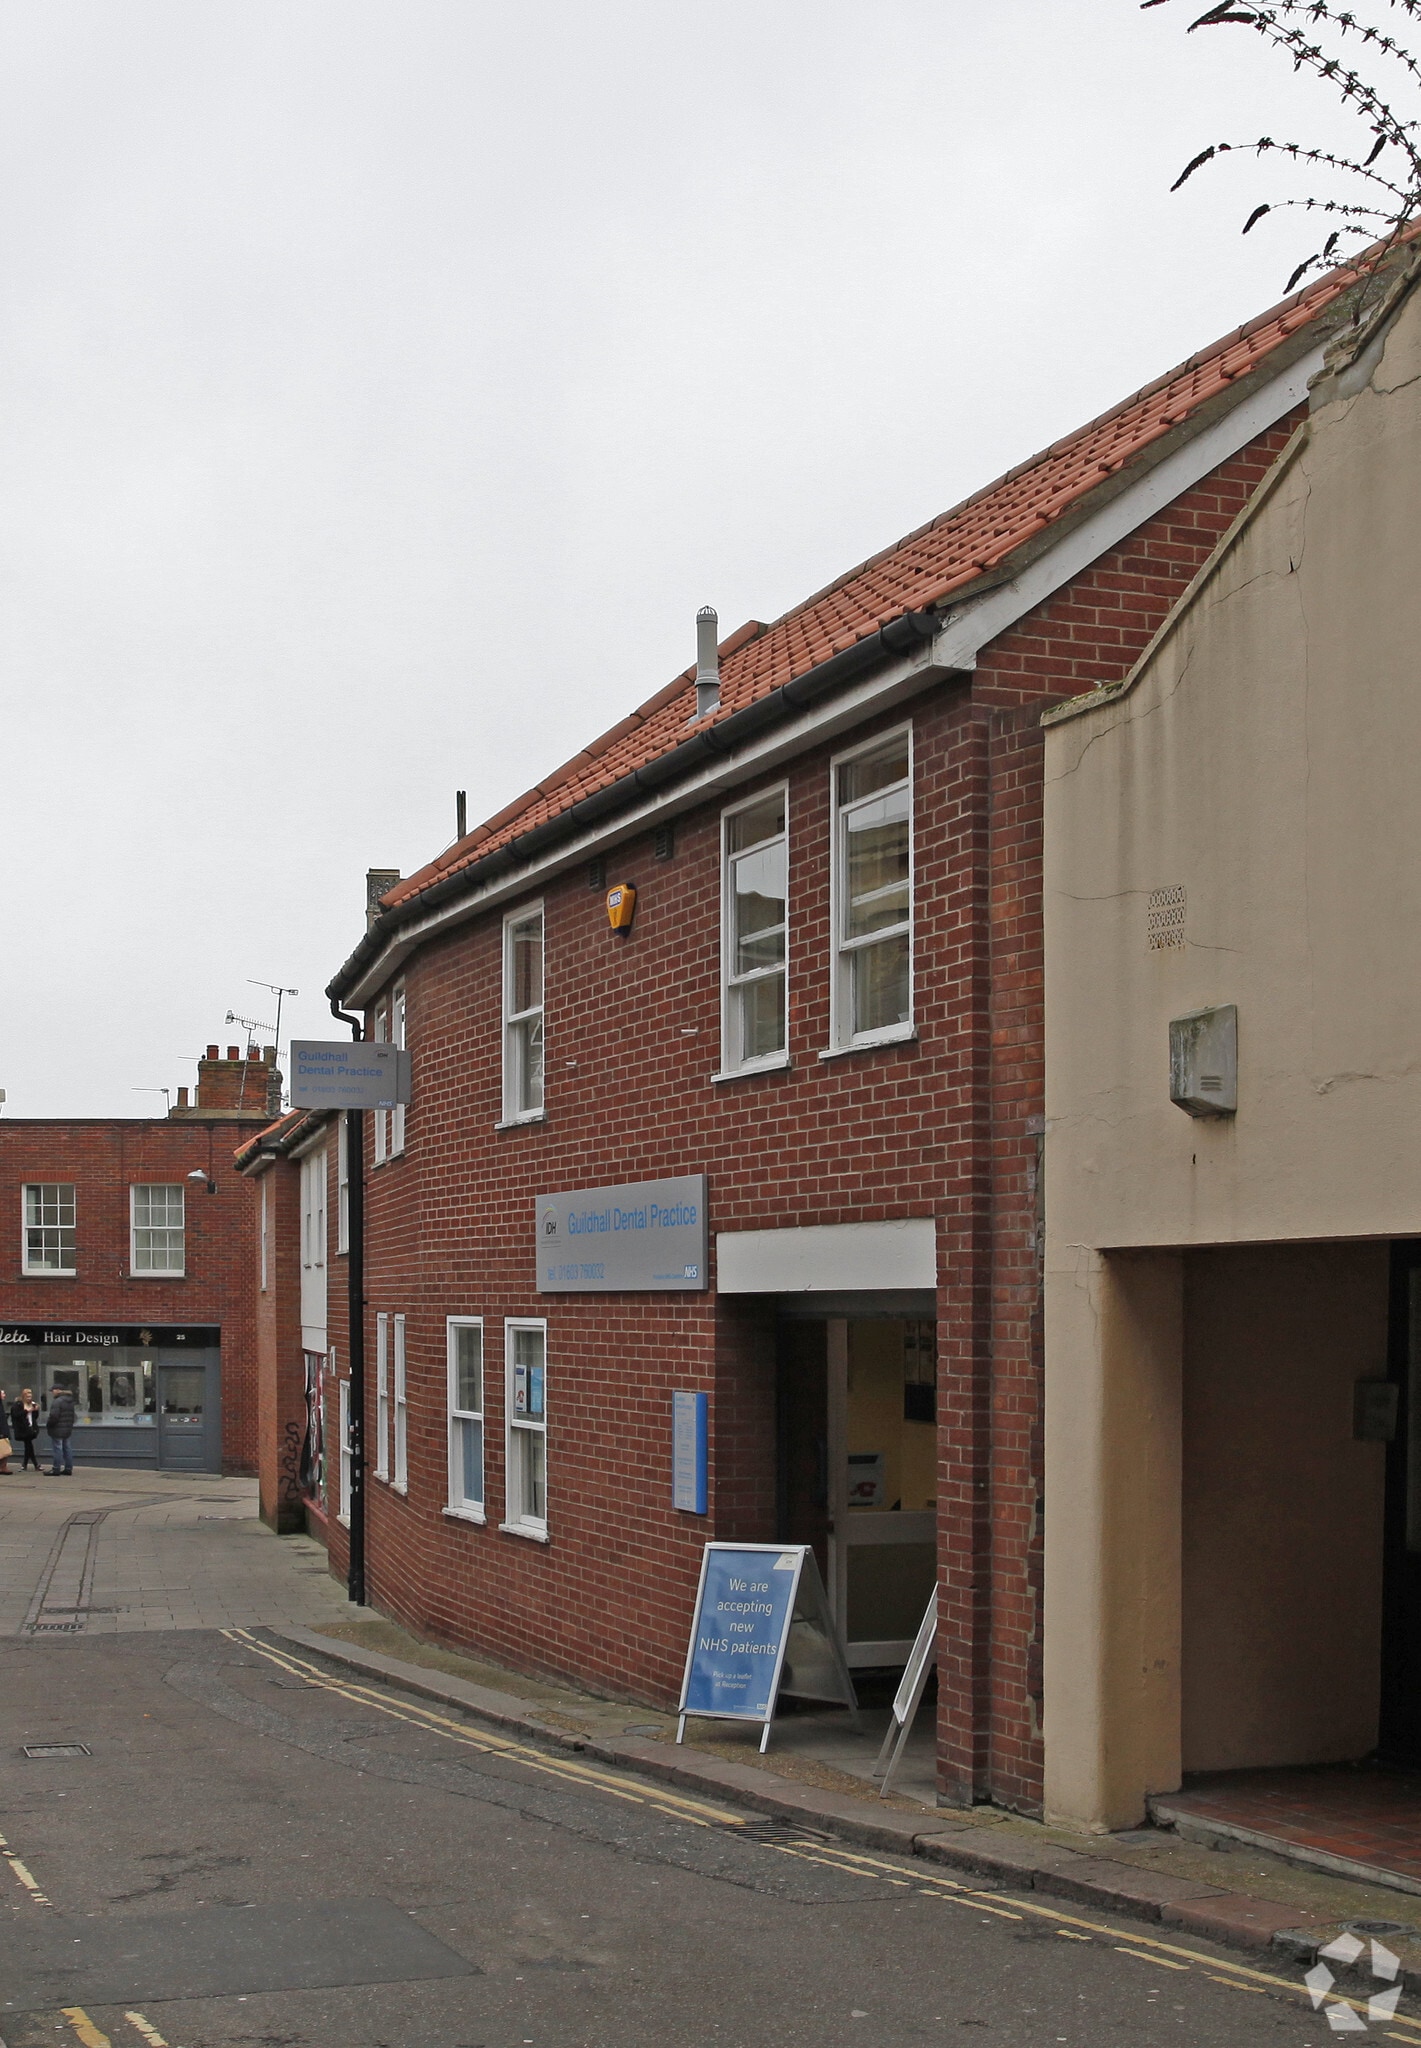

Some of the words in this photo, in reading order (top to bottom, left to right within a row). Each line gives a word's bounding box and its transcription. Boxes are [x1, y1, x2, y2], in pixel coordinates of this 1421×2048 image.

[298, 1051, 348, 1062] Guildhall
[298, 1065, 334, 1075] Dental
[337, 1066, 383, 1076] Practice
[568, 1208, 611, 1235] Guildhall
[614, 1206, 647, 1231] Dental
[651, 1201, 697, 1228] Practice
[545, 1221, 557, 1235] IDH
[684, 1265, 698, 1278] NHS
[44, 1332, 72, 1343] Hair
[76, 1331, 119, 1345] Design
[729, 1578, 747, 1592] We
[750, 1582, 769, 1593] are
[717, 1600, 773, 1617] accepting
[729, 1622, 755, 1633] new
[699, 1638, 729, 1652] NHS
[731, 1641, 778, 1656] patients
